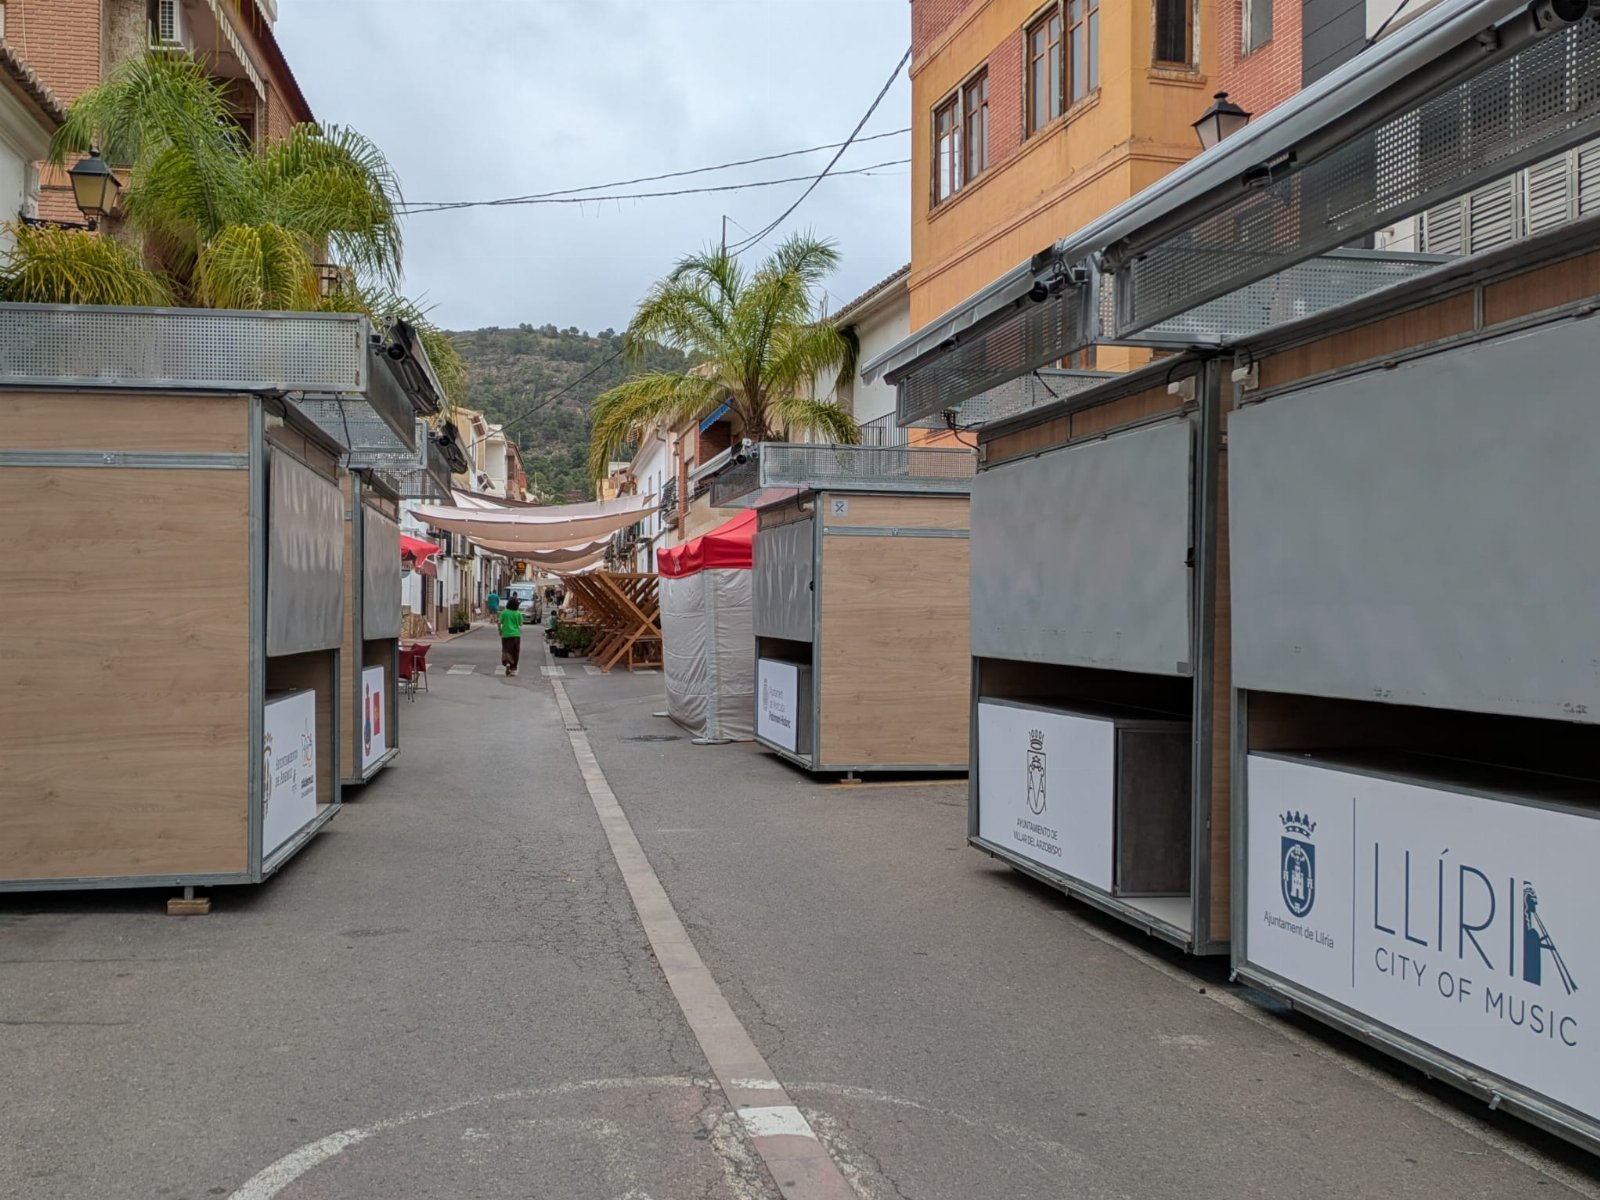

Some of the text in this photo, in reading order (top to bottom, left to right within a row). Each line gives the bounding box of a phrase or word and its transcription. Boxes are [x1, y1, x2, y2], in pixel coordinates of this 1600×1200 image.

[1263, 911, 1303, 937] Ajuntament
[1304, 926, 1314, 941] de
[1374, 947, 1577, 1047] CITY OF MUSIC
